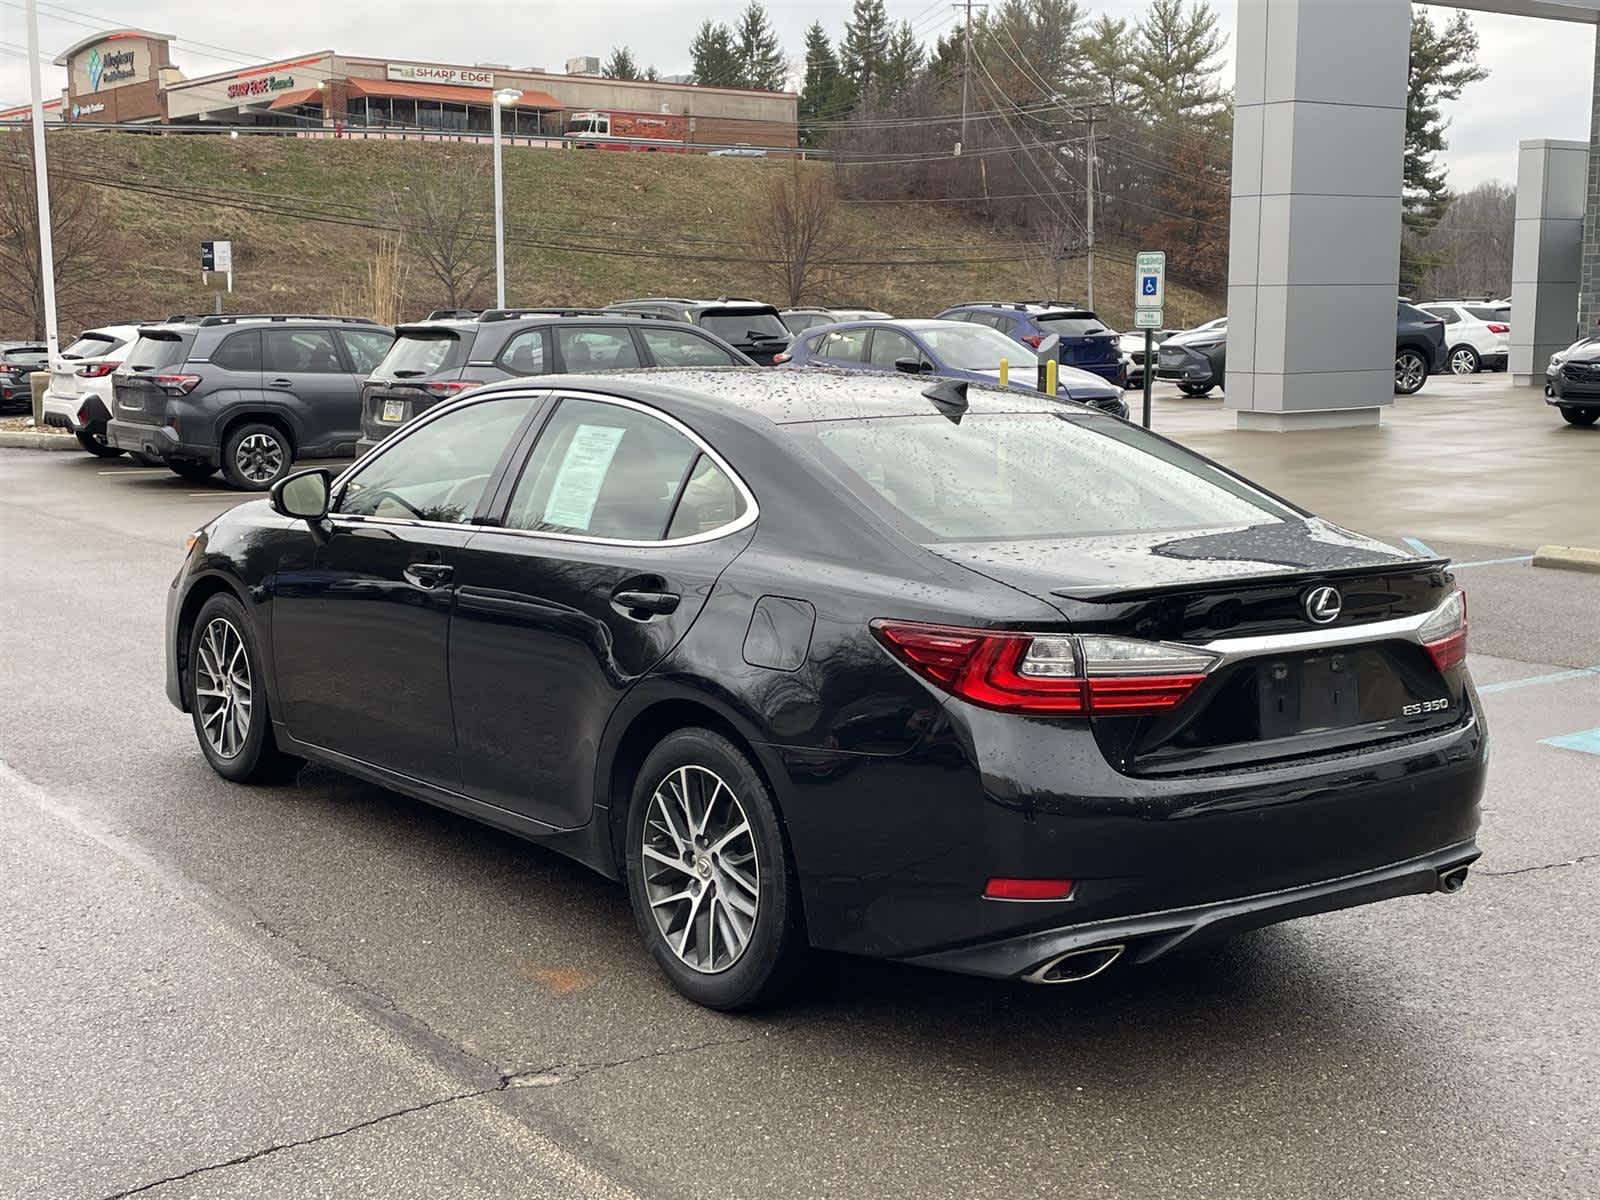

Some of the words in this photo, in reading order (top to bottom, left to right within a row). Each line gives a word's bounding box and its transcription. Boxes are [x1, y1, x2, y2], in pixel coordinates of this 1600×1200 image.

[416, 68, 457, 80] SHARP
[461, 71, 491, 83] EDGE
[227, 82, 250, 98] SHARP
[250, 79, 268, 95] EDGE
[1402, 703, 1422, 716] ES
[1422, 698, 1449, 713] 350
